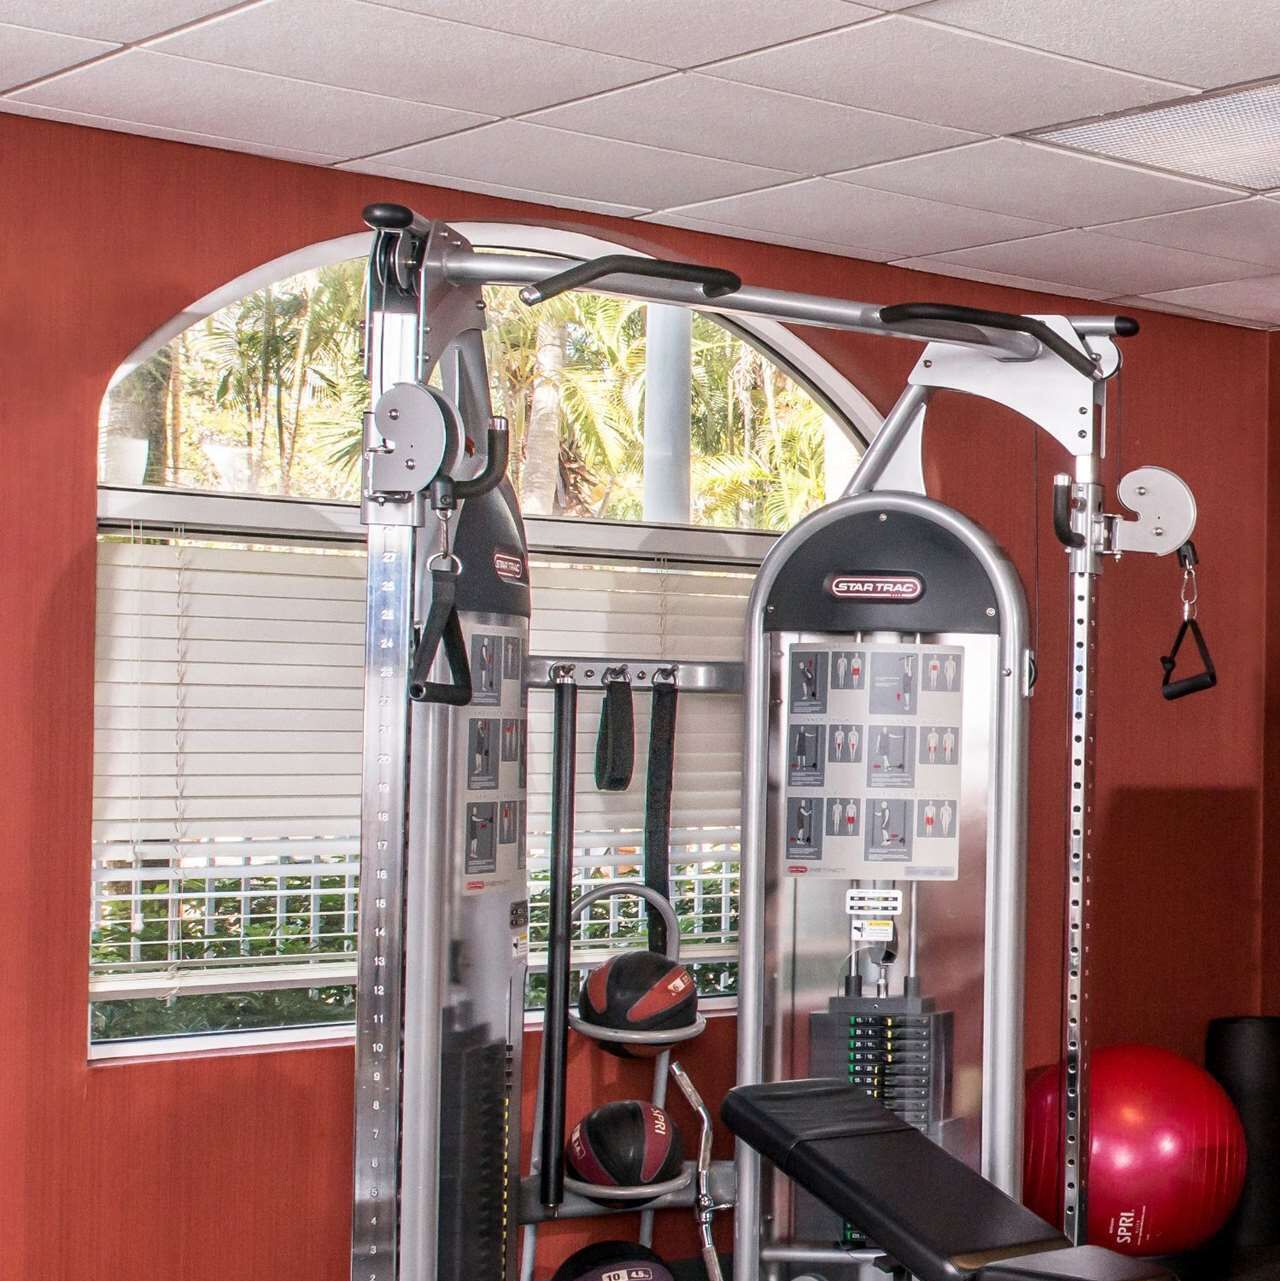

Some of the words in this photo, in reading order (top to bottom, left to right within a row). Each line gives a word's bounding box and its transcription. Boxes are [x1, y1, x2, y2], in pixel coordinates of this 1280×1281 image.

[834, 582, 873, 592] STAR
[875, 582, 915, 593] TRAC
[378, 811, 388, 821] 18
[377, 841, 387, 850] 17
[376, 870, 387, 880] 16
[376, 898, 386, 908] 15
[375, 927, 385, 936] 14
[374, 957, 385, 966] 13
[374, 985, 384, 995] 12
[374, 1014, 383, 1023] 11
[372, 1043, 383, 1052] 10
[373, 1072, 380, 1081] 9
[372, 1100, 379, 1110] 8
[650, 1107, 667, 1136] SPRI
[372, 1129, 379, 1138] 7
[370, 1216, 377, 1225] 4
[1116, 1211, 1136, 1245] SPRI
[370, 1245, 377, 1254] 3
[607, 1273, 621, 1281] 10
